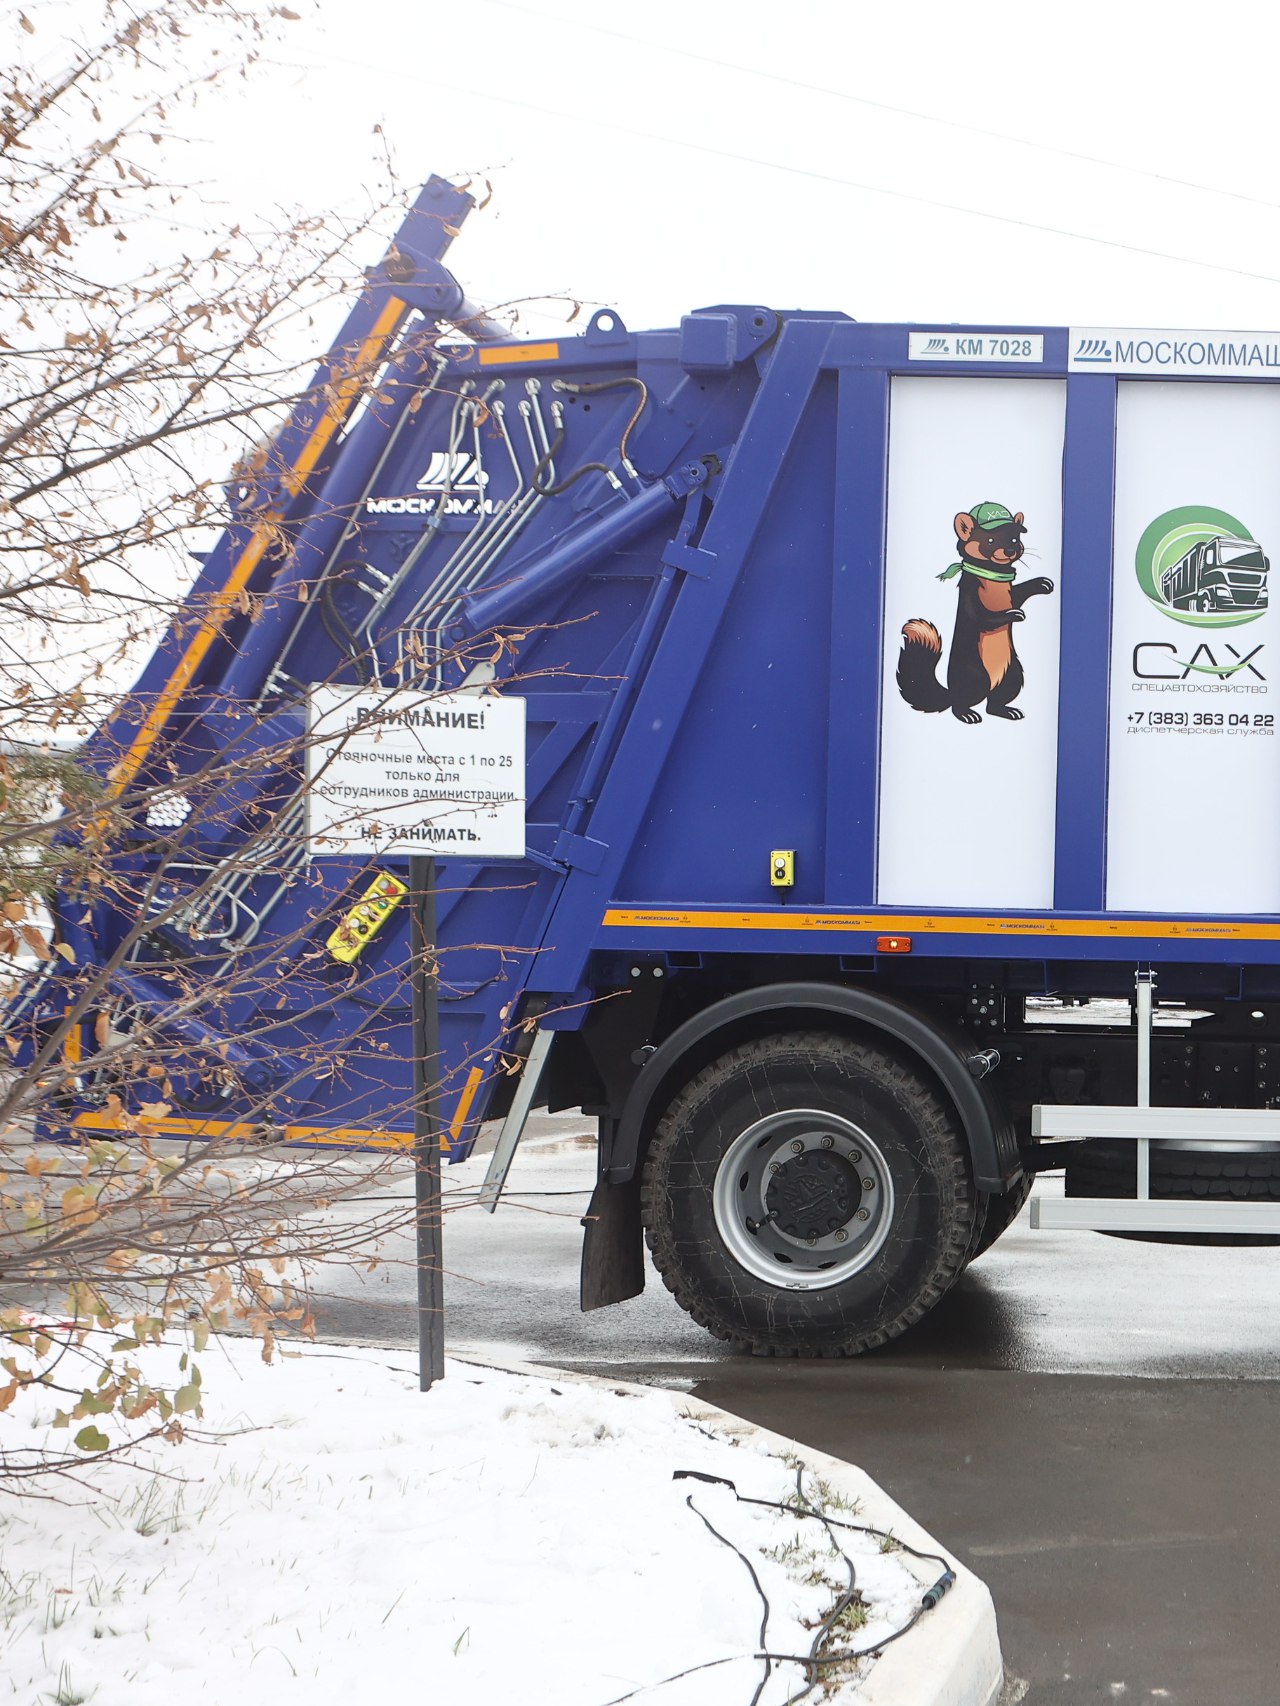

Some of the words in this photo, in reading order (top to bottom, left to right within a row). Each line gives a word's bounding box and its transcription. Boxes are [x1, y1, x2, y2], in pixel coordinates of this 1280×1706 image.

[955, 338, 983, 356] КМ
[989, 339, 1033, 357] 7028
[1133, 642, 1267, 680] САХ
[1131, 683, 1268, 694] СПЕЦАВТОХОЗЯЙСТВО
[1127, 712, 1145, 725] +7
[1148, 711, 1189, 727] (383)
[1193, 713, 1224, 726] 363
[1228, 714, 1250, 727] 04
[1253, 715, 1275, 727] 22
[1127, 726, 1224, 736] диспетчерская
[1227, 727, 1275, 737] служба
[416, 754, 455, 766] места
[459, 756, 466, 765] с
[470, 754, 475, 766] 1
[480, 756, 496, 767] по
[499, 755, 513, 767] 25
[385, 770, 431, 782] только
[435, 772, 460, 783] для
[320, 785, 409, 799] сотрудников
[361, 827, 383, 840] НЕ
[388, 827, 481, 841] ЗАНИМАТЬ.
